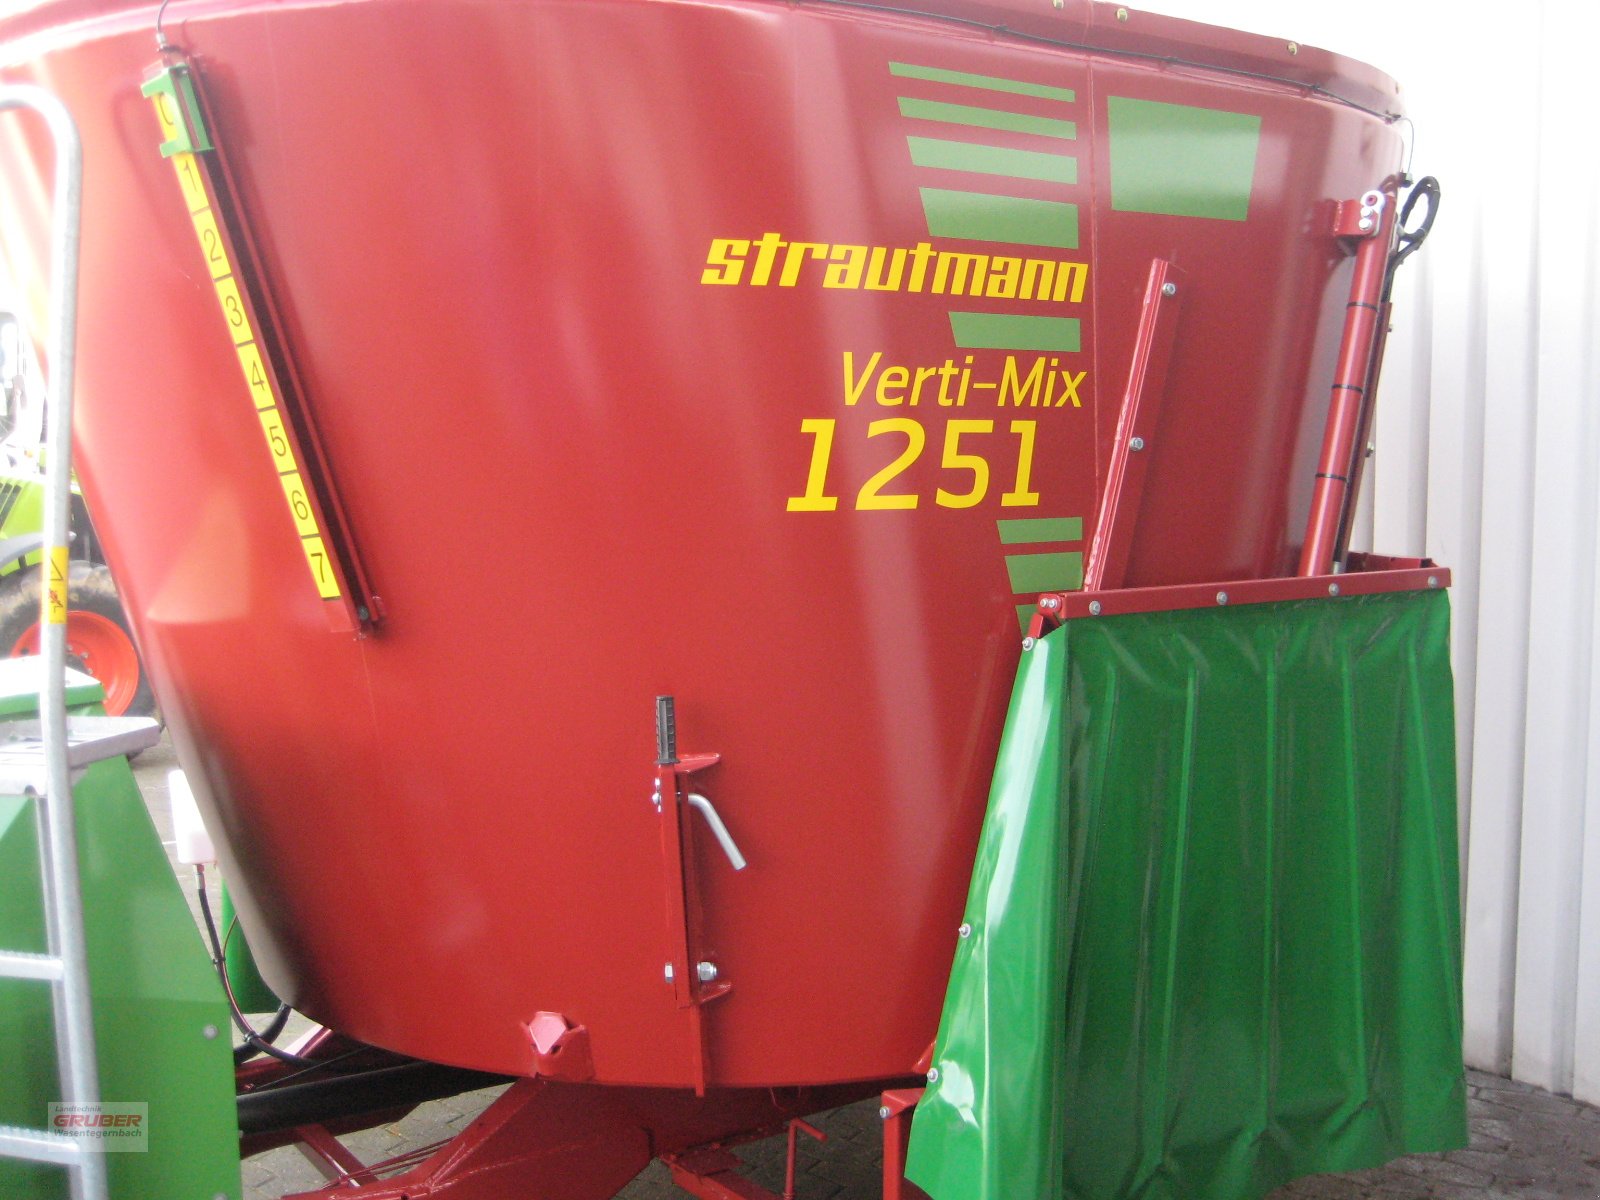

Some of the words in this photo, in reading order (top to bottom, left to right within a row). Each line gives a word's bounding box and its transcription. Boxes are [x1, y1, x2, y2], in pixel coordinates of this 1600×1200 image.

[182, 159, 199, 193] 1
[203, 228, 222, 263] 2
[700, 232, 1089, 303] strautmann
[225, 295, 243, 327] 3
[251, 359, 266, 391] 4
[842, 351, 1088, 408] Verti-Mix
[268, 425, 287, 457] 5
[786, 417, 1040, 512] 1251
[291, 489, 309, 521] 6
[310, 552, 326, 584] 7
